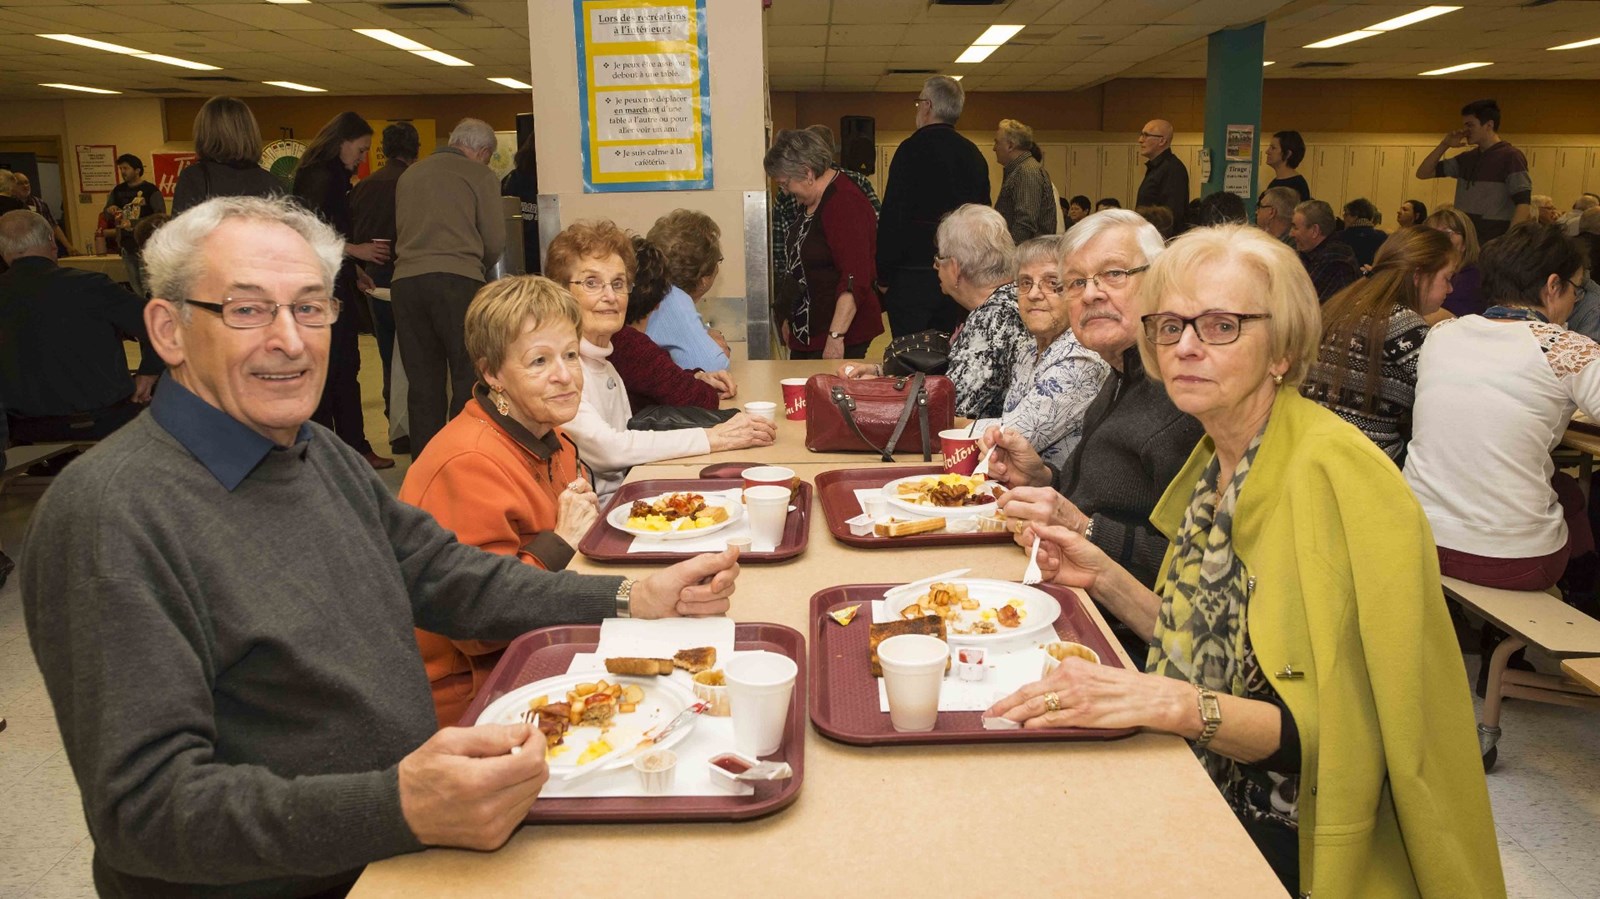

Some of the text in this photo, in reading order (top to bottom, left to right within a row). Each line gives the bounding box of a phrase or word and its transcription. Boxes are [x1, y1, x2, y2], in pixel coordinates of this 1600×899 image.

[598, 14, 618, 23] Lors
[620, 13, 635, 22] des
[613, 26, 619, 34] à
[613, 62, 621, 70] Je
[622, 62, 641, 70] peux
[615, 97, 622, 105] Je
[624, 97, 642, 106] peux
[625, 106, 660, 114] marchant
[670, 116, 688, 124] pour
[622, 149, 630, 158] Je
[647, 148, 669, 156] calme
